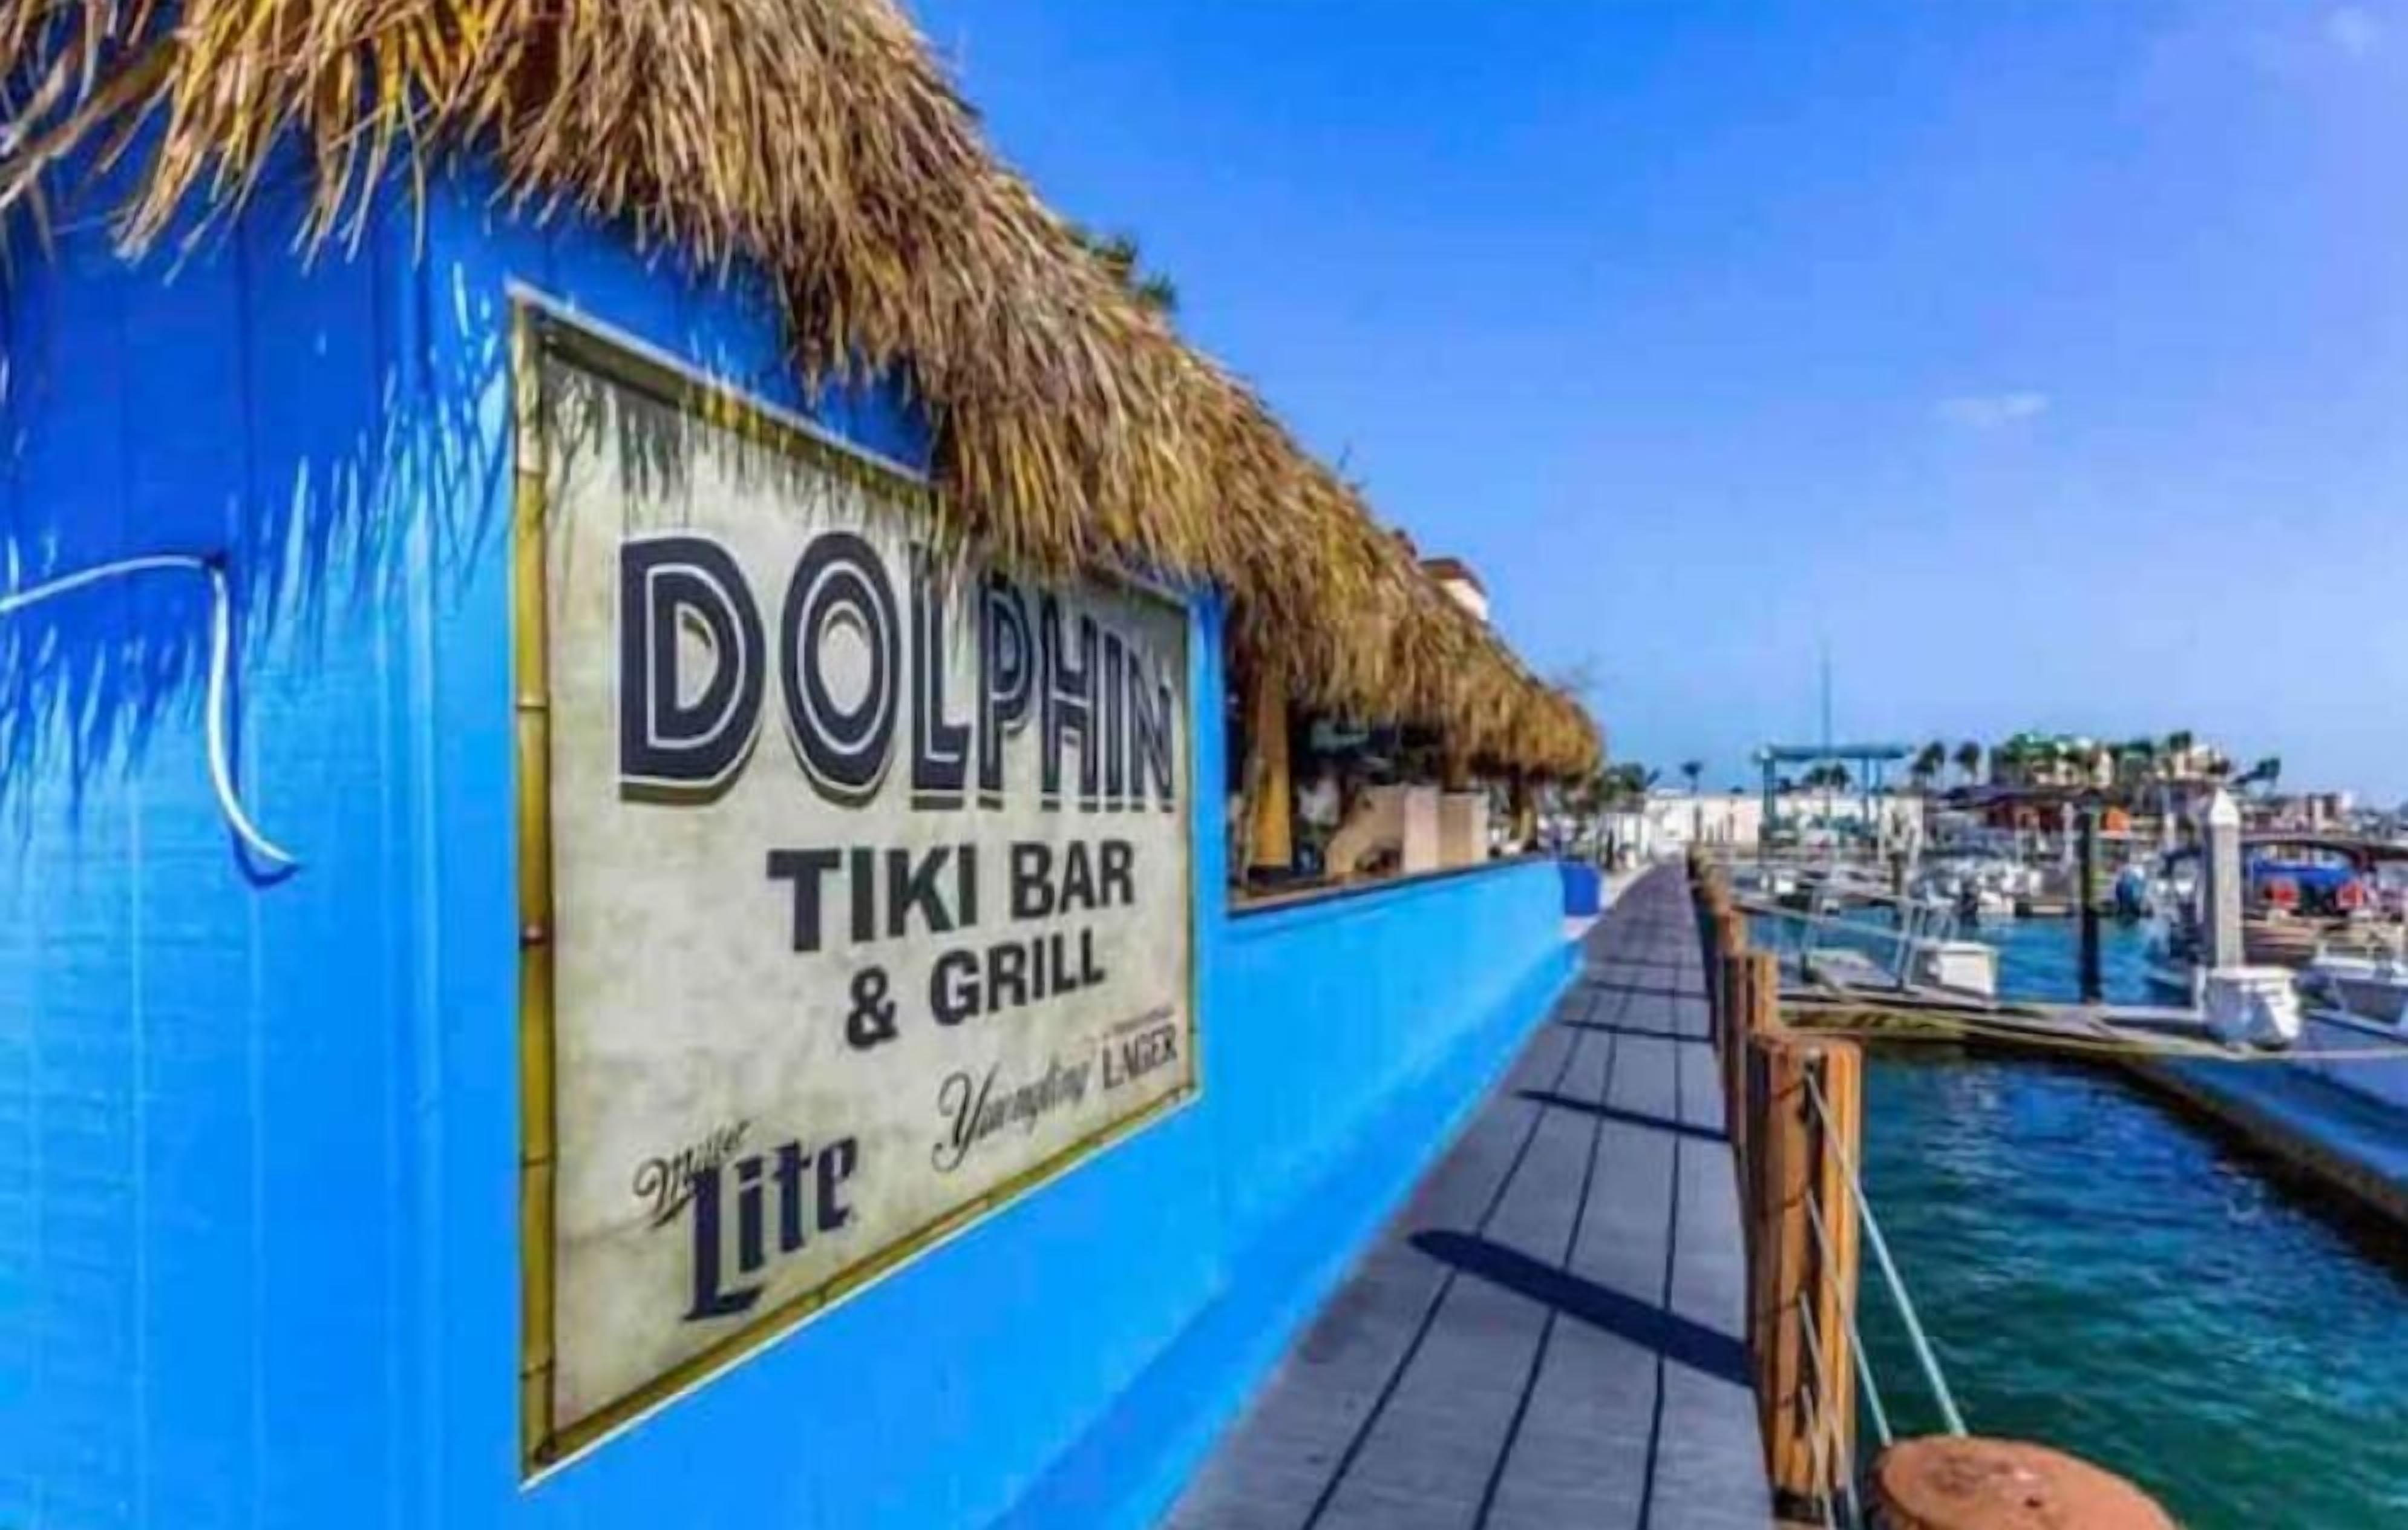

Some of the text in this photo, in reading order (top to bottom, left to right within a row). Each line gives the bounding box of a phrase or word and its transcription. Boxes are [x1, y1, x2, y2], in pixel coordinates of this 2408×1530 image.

[619, 530, 1175, 811] DOLPHIN
[766, 839, 1135, 952] TIKI BAR
[846, 928, 1105, 1051] & GRILL
[1102, 1023, 1178, 1090] LAGER
[679, 1135, 858, 1322] Lite
